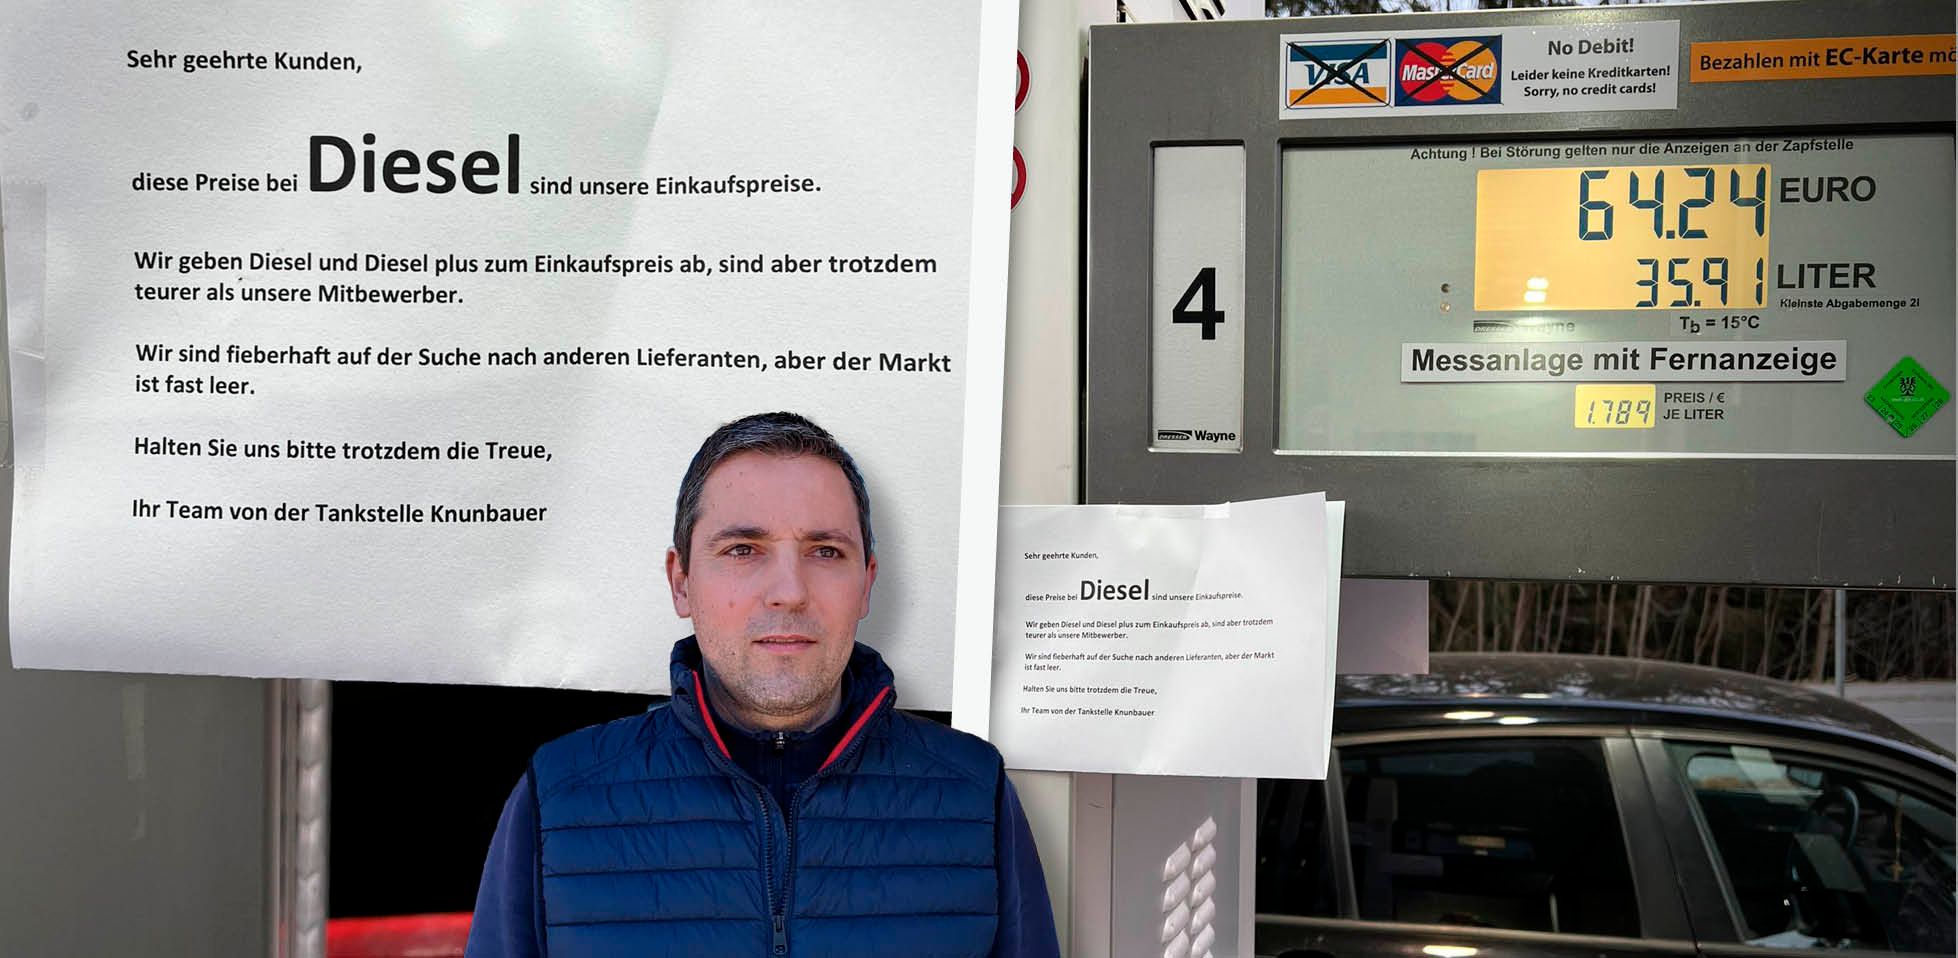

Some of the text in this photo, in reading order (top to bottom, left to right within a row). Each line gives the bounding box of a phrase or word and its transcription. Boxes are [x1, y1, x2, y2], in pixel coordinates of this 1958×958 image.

[1548, 38, 1634, 56] No Debit!
[127, 49, 361, 73] Sehr geehrte Kunden,
[1700, 52, 1784, 71] Bezahlen
[1789, 51, 1821, 68] mit
[1826, 47, 1924, 66] EC-Karte
[1511, 65, 1670, 81] Leider keine Kreditkarten!
[1524, 82, 1656, 99] Sorry, no credit cards!
[1410, 148, 1467, 162] Achtung
[1480, 147, 1501, 158] Bei
[1506, 146, 1561, 159] Störung
[1565, 145, 1607, 159] gelten
[1612, 146, 1635, 155] nur
[1639, 143, 1660, 154] die
[1663, 142, 1729, 156] Anzeigen
[1734, 144, 1751, 152] an
[1755, 141, 1779, 152] der
[1783, 138, 1854, 153] Zapfstelle
[132, 133, 821, 197] diese Preise bei Diesel sind unsere Einkaufspreise.
[1780, 176, 1876, 203] EURO
[1579, 167, 1766, 241] 64.24
[134, 251, 936, 277] Wir geben Diesel und Diesel plus zum Einkaufspreis ab, sind aber trotzdem
[1636, 257, 1763, 307] 35.91
[1777, 263, 1876, 289] LITER
[134, 282, 463, 303] teurer als unsere Mitbewerber.
[1172, 267, 1225, 340] 4
[1780, 298, 1823, 308] Kleinste
[1826, 298, 1906, 310] Abgabemenge
[1721, 315, 1760, 329] 15°C
[136, 344, 951, 372] Wir sind fieberhaft auf der Suche nach anderen Lieferanten, aber der Markt
[1412, 346, 1837, 377] Messanlage mit Fernanzeige
[136, 374, 254, 394] ist fast leer.
[1664, 392, 1705, 403] PREIS
[1717, 392, 1725, 403] €
[1588, 400, 1651, 424] 1.789
[1663, 409, 1724, 420] JE LITER
[1194, 430, 1236, 443] Wayne
[135, 437, 552, 462] Halten Sie uns bitte trotzdem die Treue,
[133, 499, 547, 523] Ihr Team von der Tankstelle Knunbauer
[1024, 552, 1041, 560] Sehr
[1042, 552, 1069, 561] geehrte
[1045, 593, 1066, 601] Preise
[1067, 593, 1078, 601] bei
[1081, 579, 1149, 600] Diesel
[1152, 593, 1168, 601] sind
[1039, 621, 1060, 629] geben
[1118, 621, 1133, 629] plus
[1153, 621, 1200, 629] Einkaufspreis
[1201, 620, 1211, 628] ab,
[1212, 619, 1225, 627] sind
[1226, 619, 1242, 627] aber
[1243, 618, 1273, 626] trotzdem
[1057, 630, 1080, 639] unsere
[1033, 663, 1046, 671] fast
[1112, 653, 1134, 661] Suche
[1186, 653, 1224, 661] Lieferanten,
[1045, 685, 1055, 693] Sie
[1087, 686, 1119, 694] trotzdem
[1120, 686, 1132, 694] die
[1133, 686, 1157, 695] Treue,
[1064, 707, 1076, 715] der
[1078, 708, 1113, 716] Tankstelle
